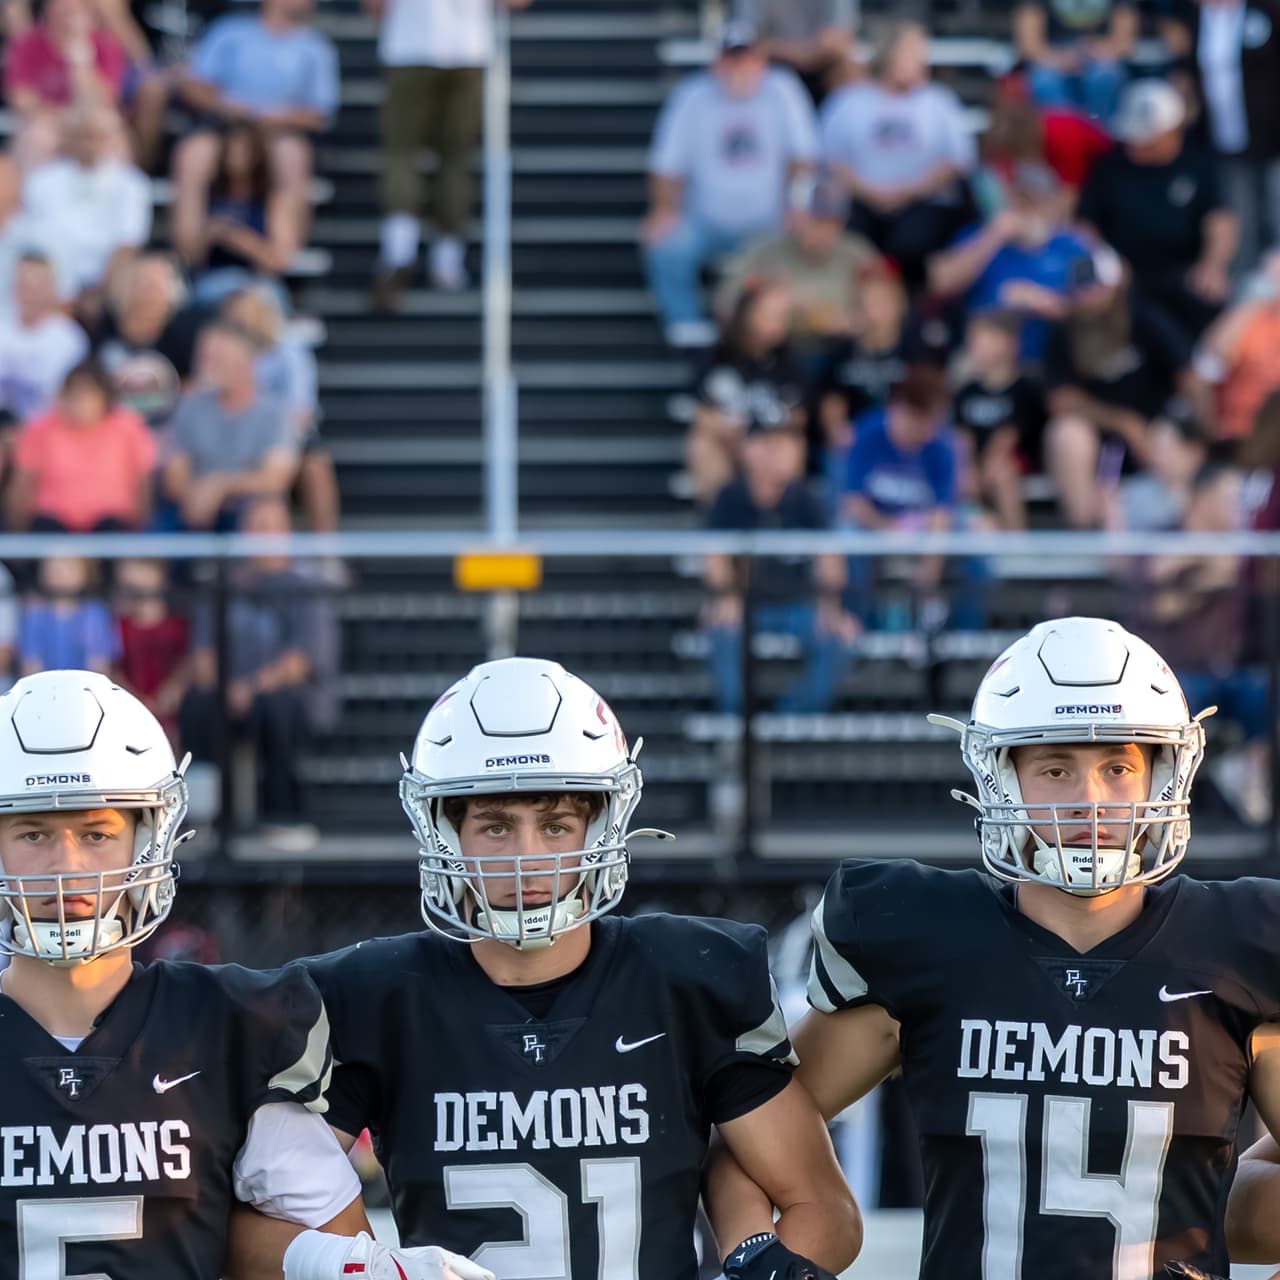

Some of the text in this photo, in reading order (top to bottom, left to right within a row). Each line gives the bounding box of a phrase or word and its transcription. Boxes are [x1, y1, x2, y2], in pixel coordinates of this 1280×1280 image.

[1055, 705, 1122, 715] DEMONS
[486, 754, 550, 768] DEMONS
[26, 774, 91, 787] DEMONS
[1072, 856, 1104, 864] Riddll
[49, 929, 82, 938] Ridell
[957, 1018, 1190, 1090] DEMONS
[433, 1082, 650, 1152] DEMONS
